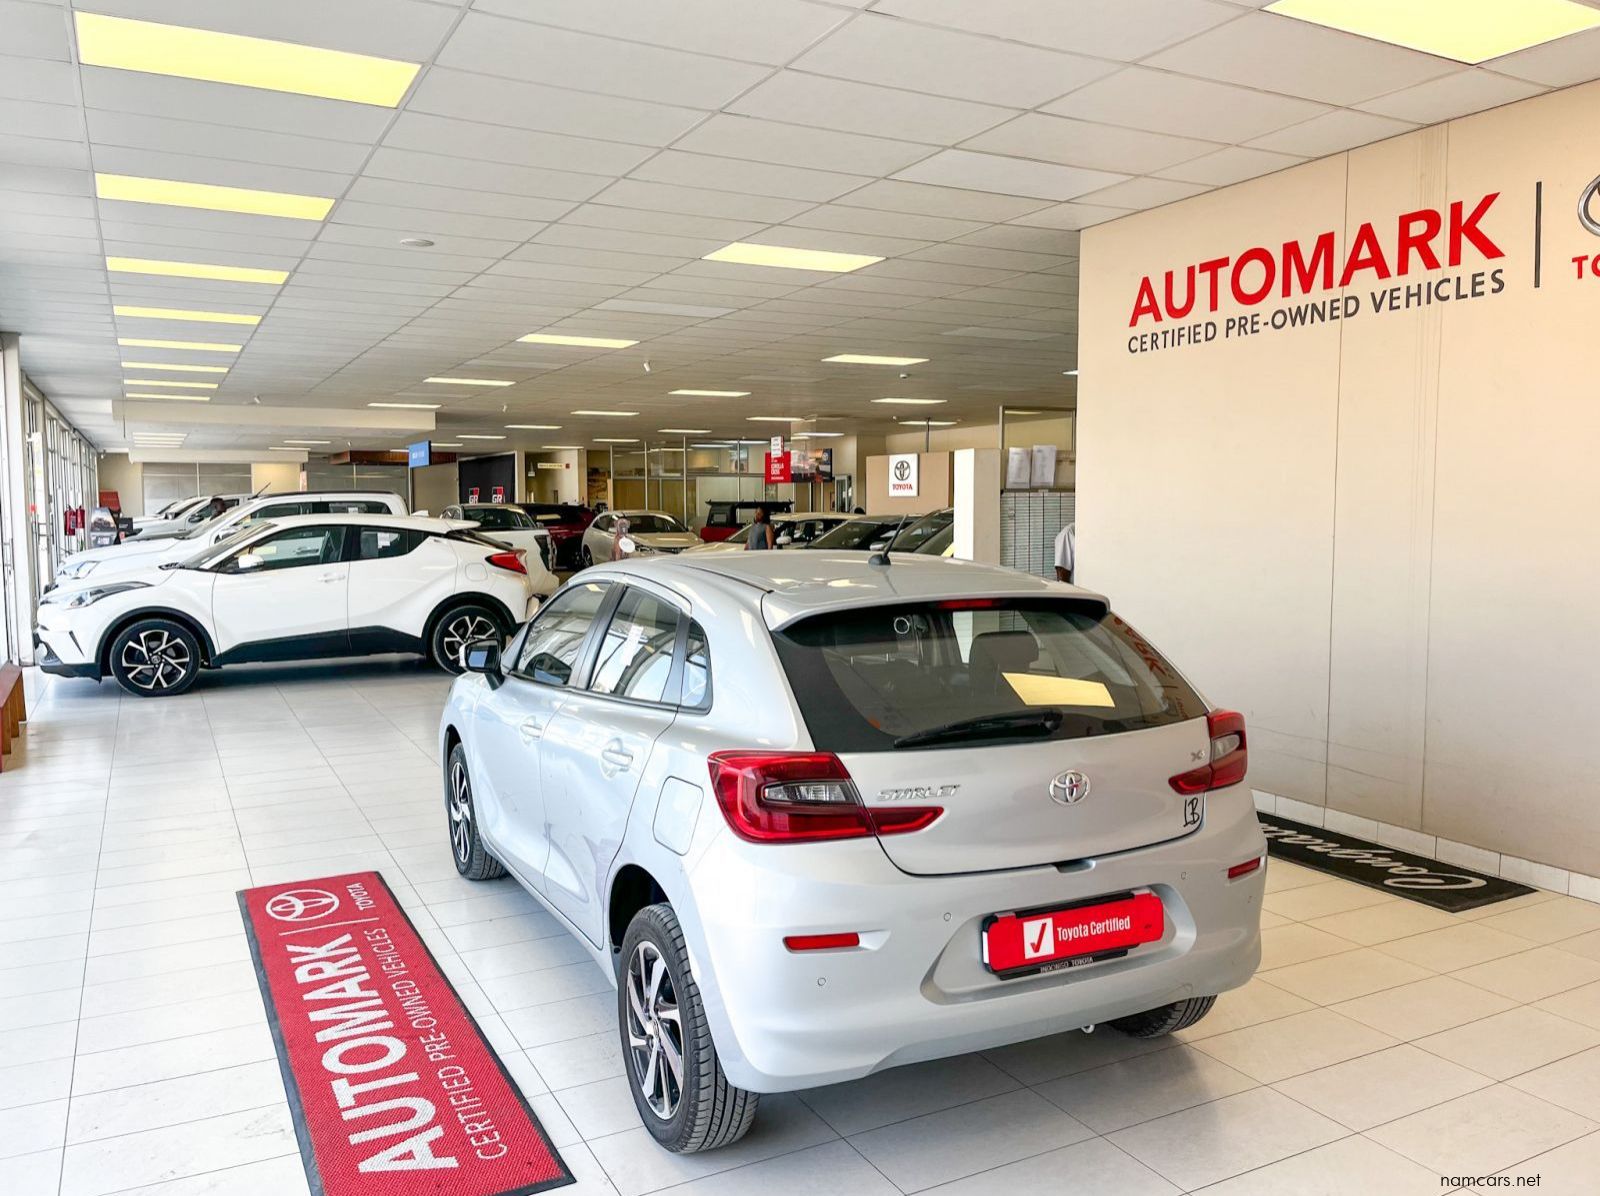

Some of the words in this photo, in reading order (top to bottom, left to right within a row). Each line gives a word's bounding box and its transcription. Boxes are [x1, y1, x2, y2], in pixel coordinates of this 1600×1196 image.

[1128, 191, 1506, 327] AUTOMARK
[1127, 320, 1218, 354] CERTIFIED
[1224, 294, 1361, 339] PRE-OWNED
[1370, 268, 1506, 314] VEHICLES
[892, 483, 913, 491] TOYOTA
[877, 784, 961, 804] STARLET
[346, 882, 376, 911] TOYOTA
[1056, 922, 1089, 942] Toyota
[1090, 915, 1131, 936] Certified
[364, 927, 410, 978] VEHICLES
[286, 933, 459, 1173] AUTOMARK
[392, 980, 455, 1061] PRE-OWNED
[442, 1065, 509, 1160] CERTIFIED
